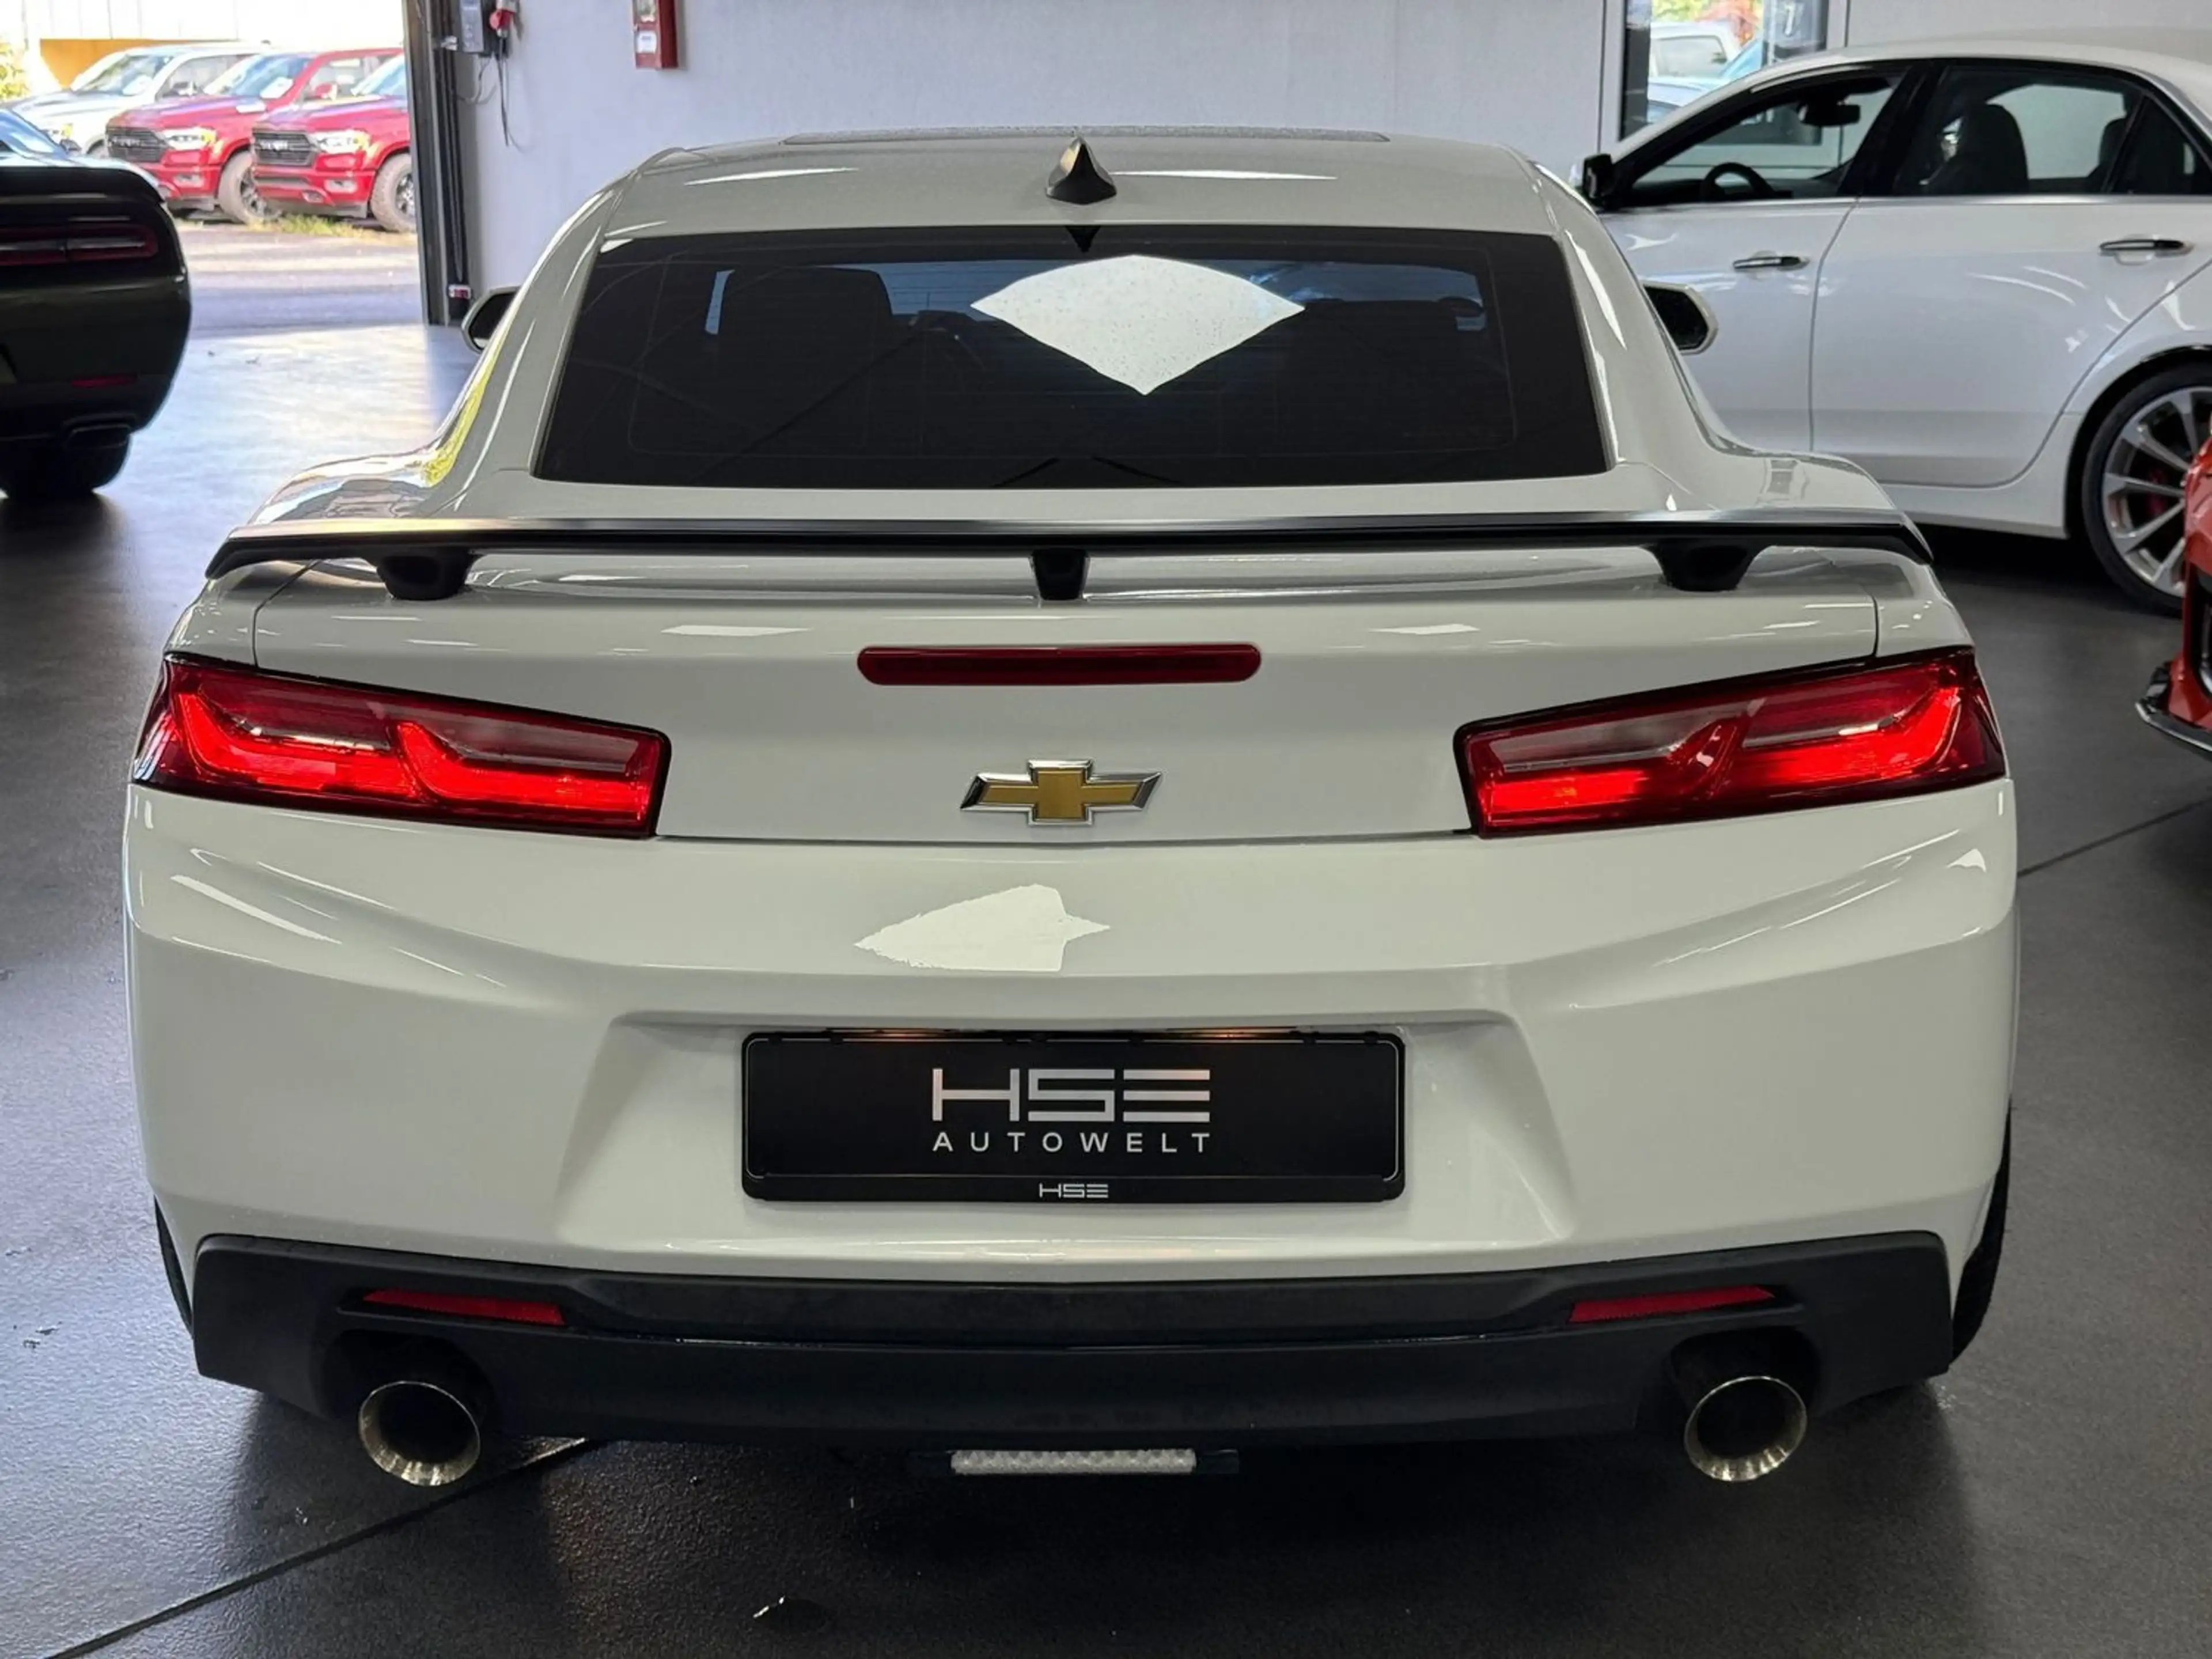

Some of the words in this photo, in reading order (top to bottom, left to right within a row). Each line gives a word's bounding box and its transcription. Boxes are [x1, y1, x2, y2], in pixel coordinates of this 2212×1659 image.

[933, 1069, 1210, 1122] HSE
[933, 1132, 1210, 1153] AUTOWELT
[1039, 1183, 1108, 1198] HSE
